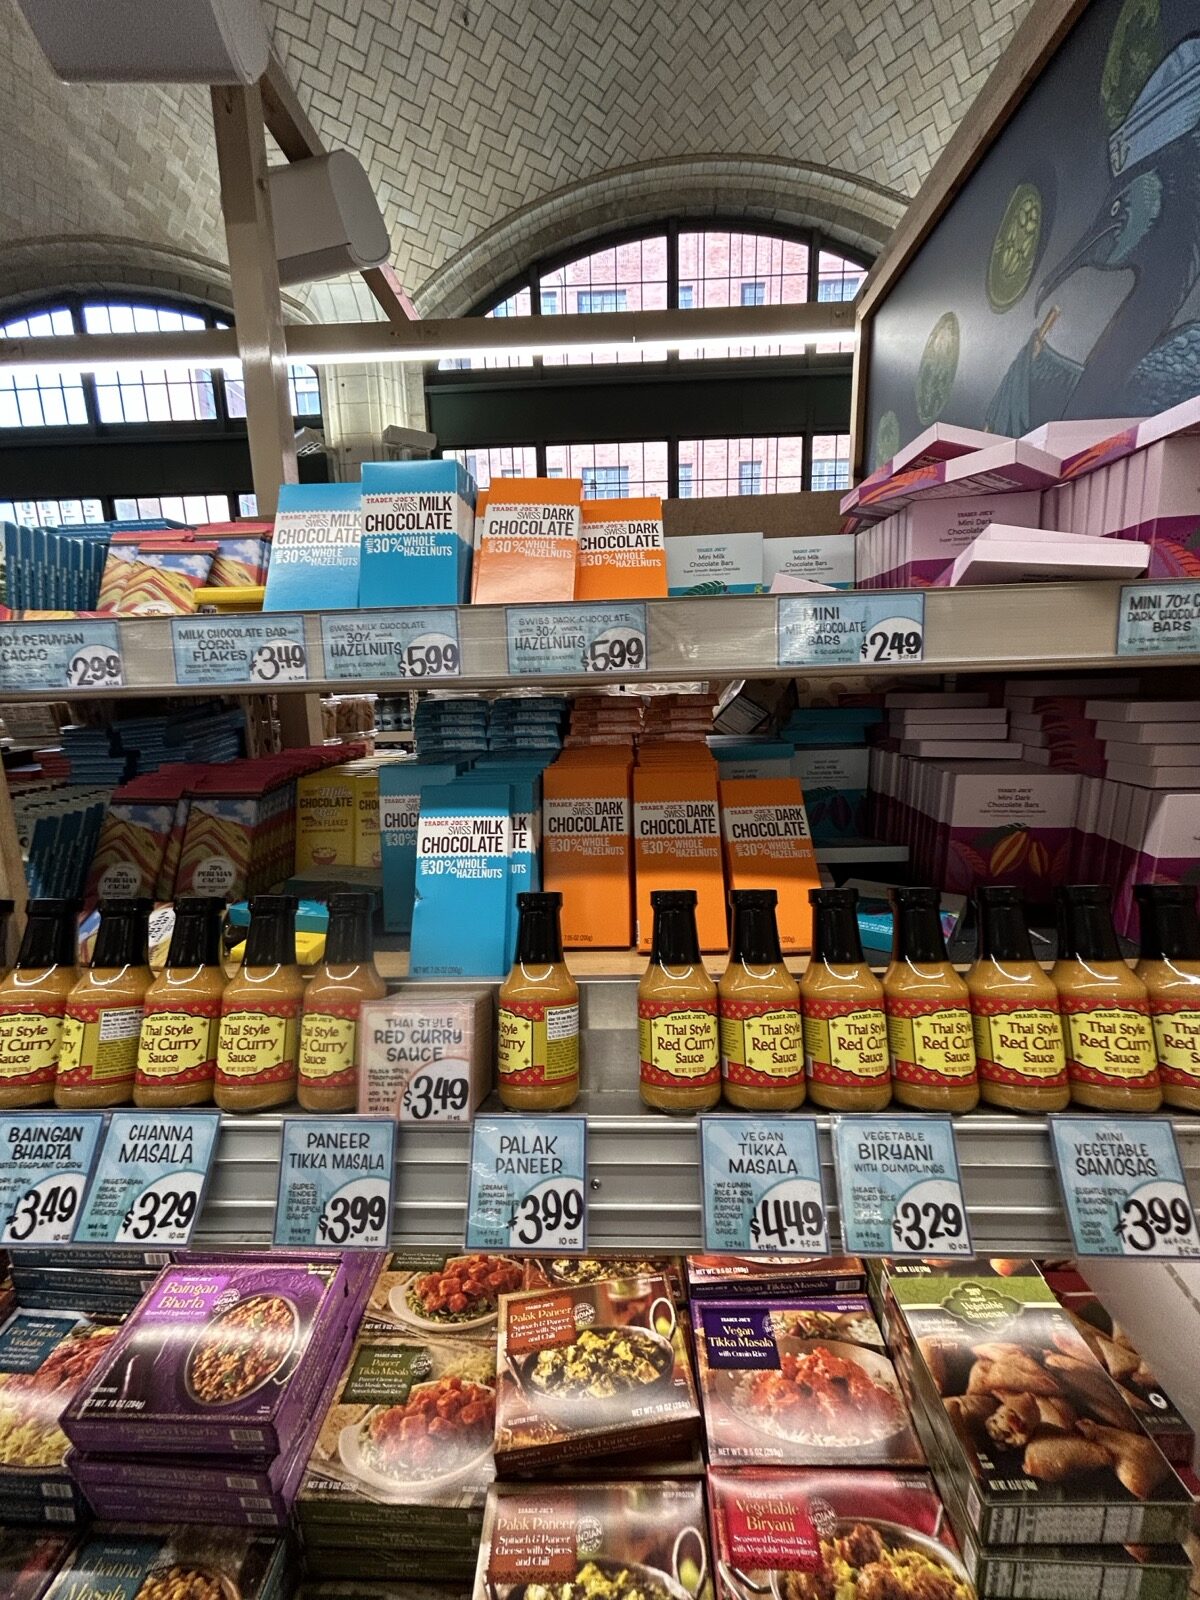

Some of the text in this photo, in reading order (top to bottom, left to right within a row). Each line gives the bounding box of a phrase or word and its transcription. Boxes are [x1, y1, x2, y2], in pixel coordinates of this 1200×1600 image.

[392, 496, 452, 512] SWISS MILK
[517, 507, 574, 521] SWISS DARK
[365, 513, 452, 532] CHOCOLATE
[489, 520, 574, 537] CHOCOLATE
[604, 523, 659, 536] SWISS DARK
[277, 528, 360, 545] CHOCOLATE
[580, 535, 660, 550] CHOCOLATE
[403, 546, 452, 557] HAZELNUTS
[495, 540, 556, 553] 30% WHOLE
[524, 549, 572, 559] HAZELNUTS
[311, 557, 358, 566] HAZELNUTS
[615, 559, 661, 568] HAZELNUTS
[1130, 595, 1161, 610] MINI
[519, 617, 550, 626] SWISS
[580, 613, 630, 623] CHOCOLATE
[803, 606, 840, 620] MINI
[1127, 611, 1155, 622] DARK
[178, 627, 287, 640] MILK CHOCOLATE BAR
[329, 621, 425, 632] SWISS MILK CHOCOLATE
[815, 621, 867, 634] CHOCOLATE
[1153, 621, 1191, 632] BARS
[198, 640, 235, 650] CORN
[346, 632, 372, 644] 30%
[514, 635, 586, 650] HAZELNUTS
[808, 635, 840, 646] BARS
[330, 641, 402, 657] HAZELNUTS
[861, 631, 922, 661] $2.49
[2, 649, 48, 662] CACAO
[193, 650, 248, 661] FLAKES
[397, 644, 459, 677] $5.99
[581, 637, 644, 672] $5.99
[249, 645, 305, 680] $3.49
[66, 655, 121, 686] $2.99
[572, 801, 623, 816] SWISS DARK
[664, 804, 715, 818] SWISS DARK
[753, 808, 803, 822] SWISS DARK
[448, 820, 503, 835] SWISS MILK
[548, 816, 624, 833] CHOCOLATE
[640, 819, 717, 835] CHOCOLATE
[732, 821, 807, 838] CHOCOLATE
[422, 836, 504, 854] CHOCOLATE
[556, 837, 610, 852] 30% WHOLE
[582, 846, 624, 856] HAZELNUTS
[675, 848, 718, 857] HAZELNUTS
[770, 849, 811, 859] HAZELNUTS
[456, 868, 503, 879] HAZELNUTS
[385, 1018, 453, 1028] THAI STYLE
[664, 1024, 711, 1036] Thai Style
[845, 1024, 868, 1035] Thai
[930, 1023, 953, 1034] Thai
[1087, 1021, 1145, 1036] Thai Style
[16, 1024, 48, 1040] Style
[224, 1024, 270, 1039] Thai Style
[374, 1029, 462, 1044] RED CURRY
[7, 1038, 56, 1052] Curry
[157, 1038, 201, 1051] Curry
[657, 1037, 716, 1051] Red Curry
[752, 1037, 776, 1051] Red
[837, 1037, 863, 1051] Red
[922, 1036, 949, 1050] Red
[1000, 1035, 1028, 1050] Red
[1163, 1034, 1196, 1050] Red
[148, 1053, 178, 1063] Sauce
[228, 1053, 256, 1062] Sauce
[386, 1047, 443, 1062] SAUCE
[676, 1053, 704, 1064] Sauce
[772, 1053, 797, 1064] Sauce
[859, 1052, 883, 1063] Sauce
[944, 1052, 970, 1062] Sauce
[1024, 1051, 1055, 1063] Sauce
[1104, 1051, 1140, 1063] Sauce
[403, 1076, 469, 1119] $3.49
[8, 1126, 84, 1143] BAINGAN
[129, 1124, 193, 1142] CHANNA
[741, 1132, 784, 1141] VEGAN
[863, 1131, 925, 1141] VEGETABLE
[1096, 1132, 1123, 1141] MINI
[307, 1132, 371, 1149] PANEER
[500, 1136, 558, 1155] PALAK
[11, 1143, 72, 1161] BHARTA
[119, 1144, 192, 1163] MASALA
[738, 1143, 787, 1156] TIKKA
[858, 1143, 934, 1160] BIRYANI
[1074, 1143, 1149, 1157] VEGETABLE
[289, 1153, 385, 1170] TIKKA MASALA
[495, 1158, 563, 1174] PANEER
[728, 1159, 798, 1175] MASALA
[854, 1163, 945, 1174] WITH DUMPLINGS
[1075, 1158, 1158, 1177] SAMOSAS
[122, 1191, 197, 1239] $3.29
[318, 1196, 386, 1244] $3.99
[750, 1200, 823, 1247] $4.49
[892, 1202, 962, 1250] $3.29
[1113, 1197, 1192, 1251] $3.99
[163, 1281, 218, 1297] Baingan
[157, 1296, 205, 1309] Bharta
[510, 1307, 572, 1324] Palak Paneer
[510, 1330, 534, 1339] Cheese
[550, 1323, 572, 1333] Spices
[723, 1325, 754, 1337] Vegan
[709, 1337, 773, 1347] Tikka Masala
[736, 1500, 799, 1516] Vegetable
[497, 1518, 575, 1531] Palak Paneer
[747, 1518, 796, 1535] Biryani
[496, 1546, 572, 1557] Cheese with Spices
[748, 1546, 779, 1556] Vegetable
[780, 1546, 817, 1556] Dumplings
[515, 1557, 550, 1567] and Chili
